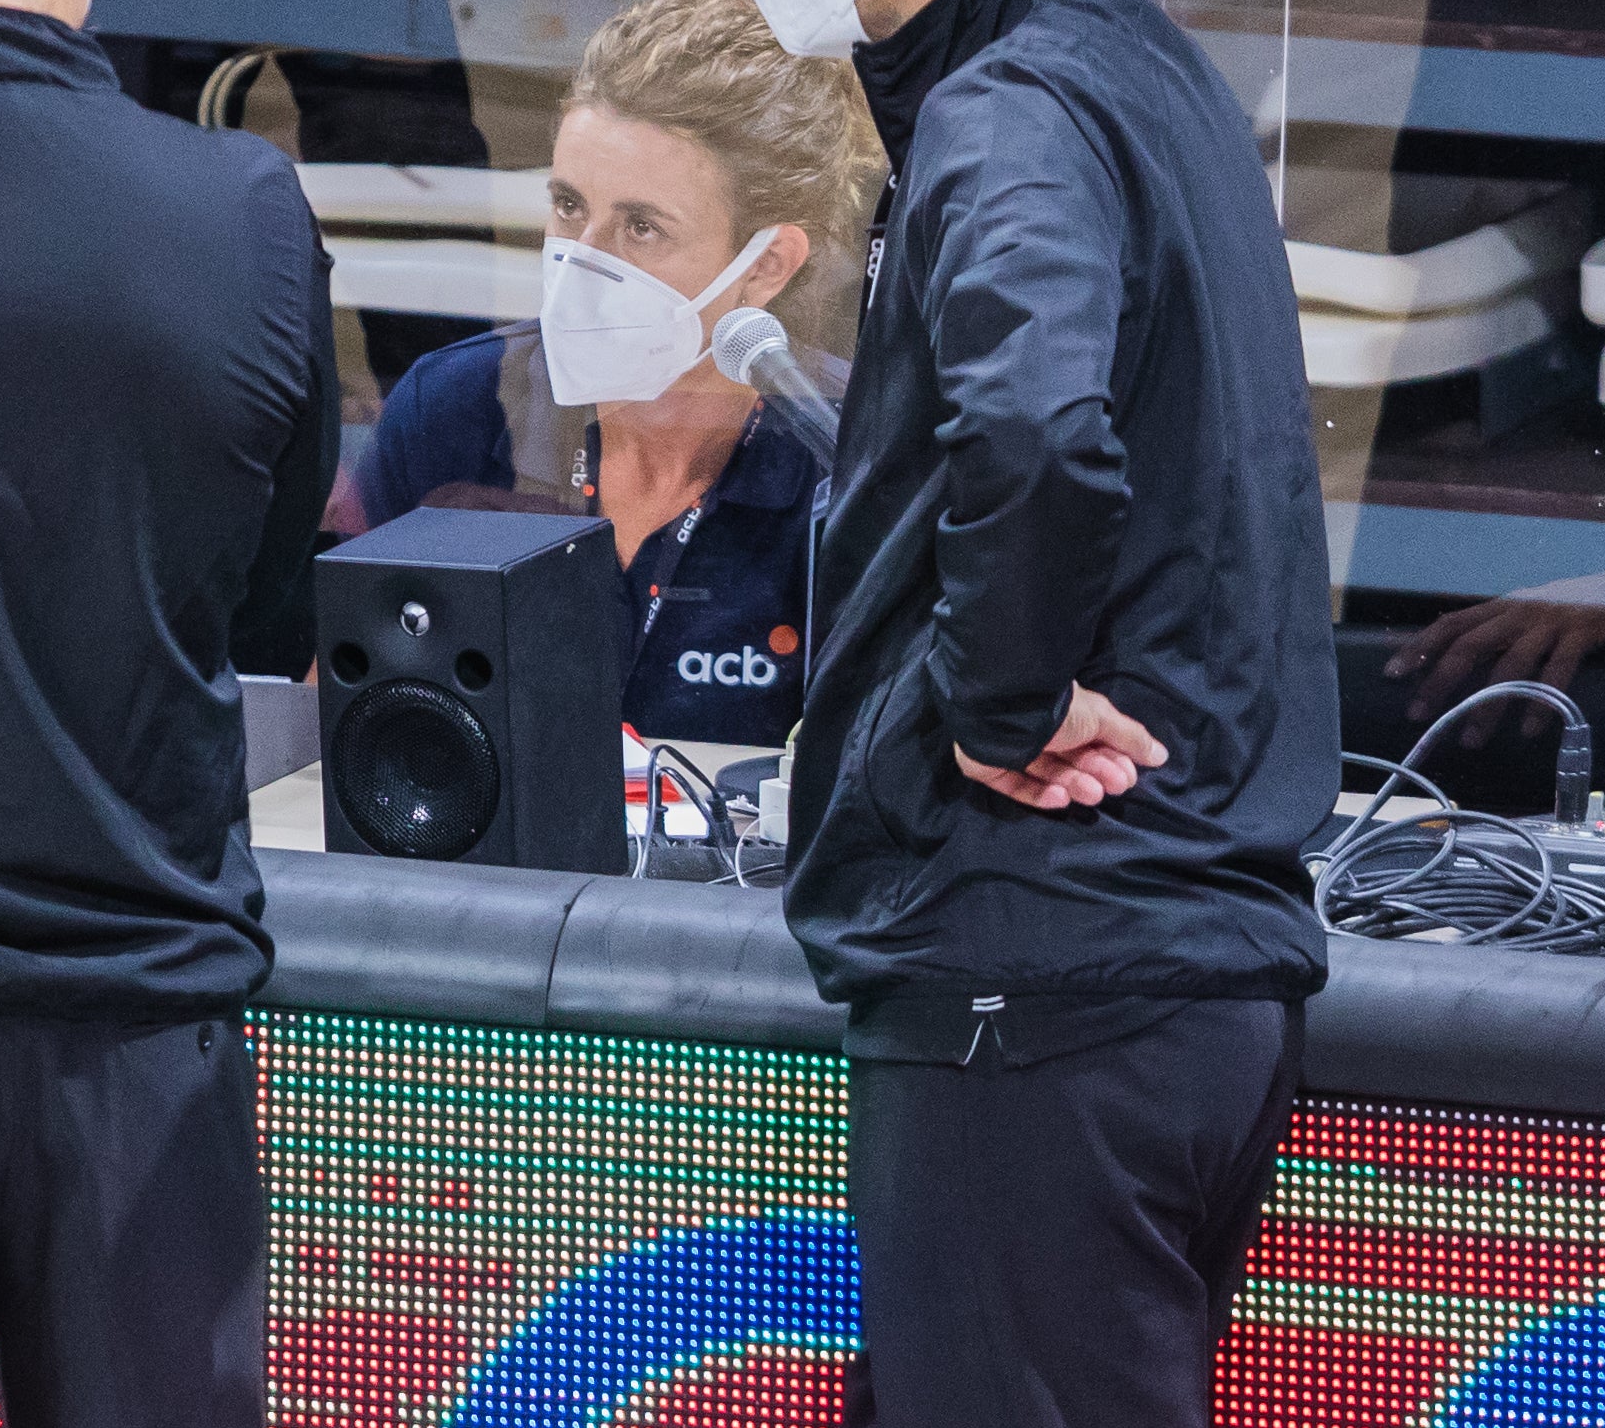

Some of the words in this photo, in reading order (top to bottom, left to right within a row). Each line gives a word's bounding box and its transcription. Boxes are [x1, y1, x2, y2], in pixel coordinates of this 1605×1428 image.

[571, 448, 587, 488] acb
[676, 507, 703, 545] acb
[677, 644, 778, 687] acb
